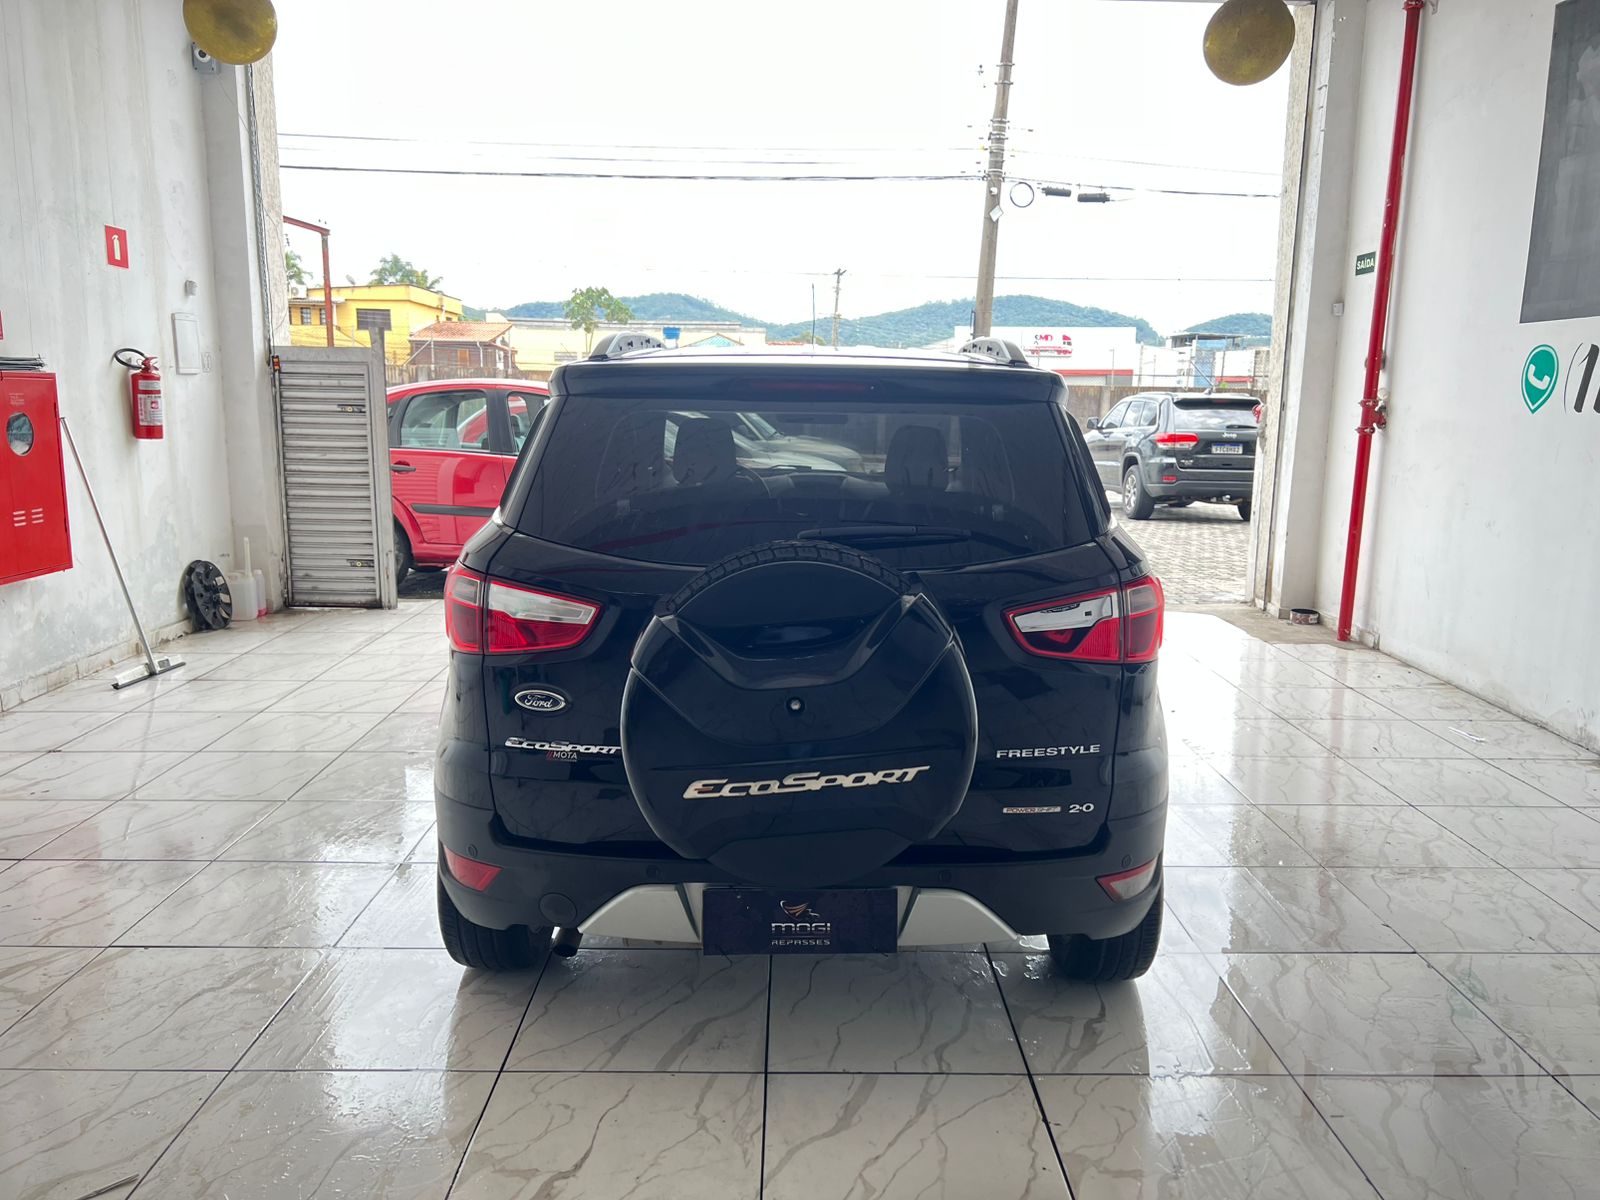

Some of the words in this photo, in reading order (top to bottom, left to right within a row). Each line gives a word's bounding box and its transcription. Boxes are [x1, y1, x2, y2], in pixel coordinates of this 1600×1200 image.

[1564, 342, 1600, 413] (1
[524, 694, 553, 708] Ford
[996, 744, 1100, 758] FREESTYLE
[771, 922, 831, 934] MOGI
